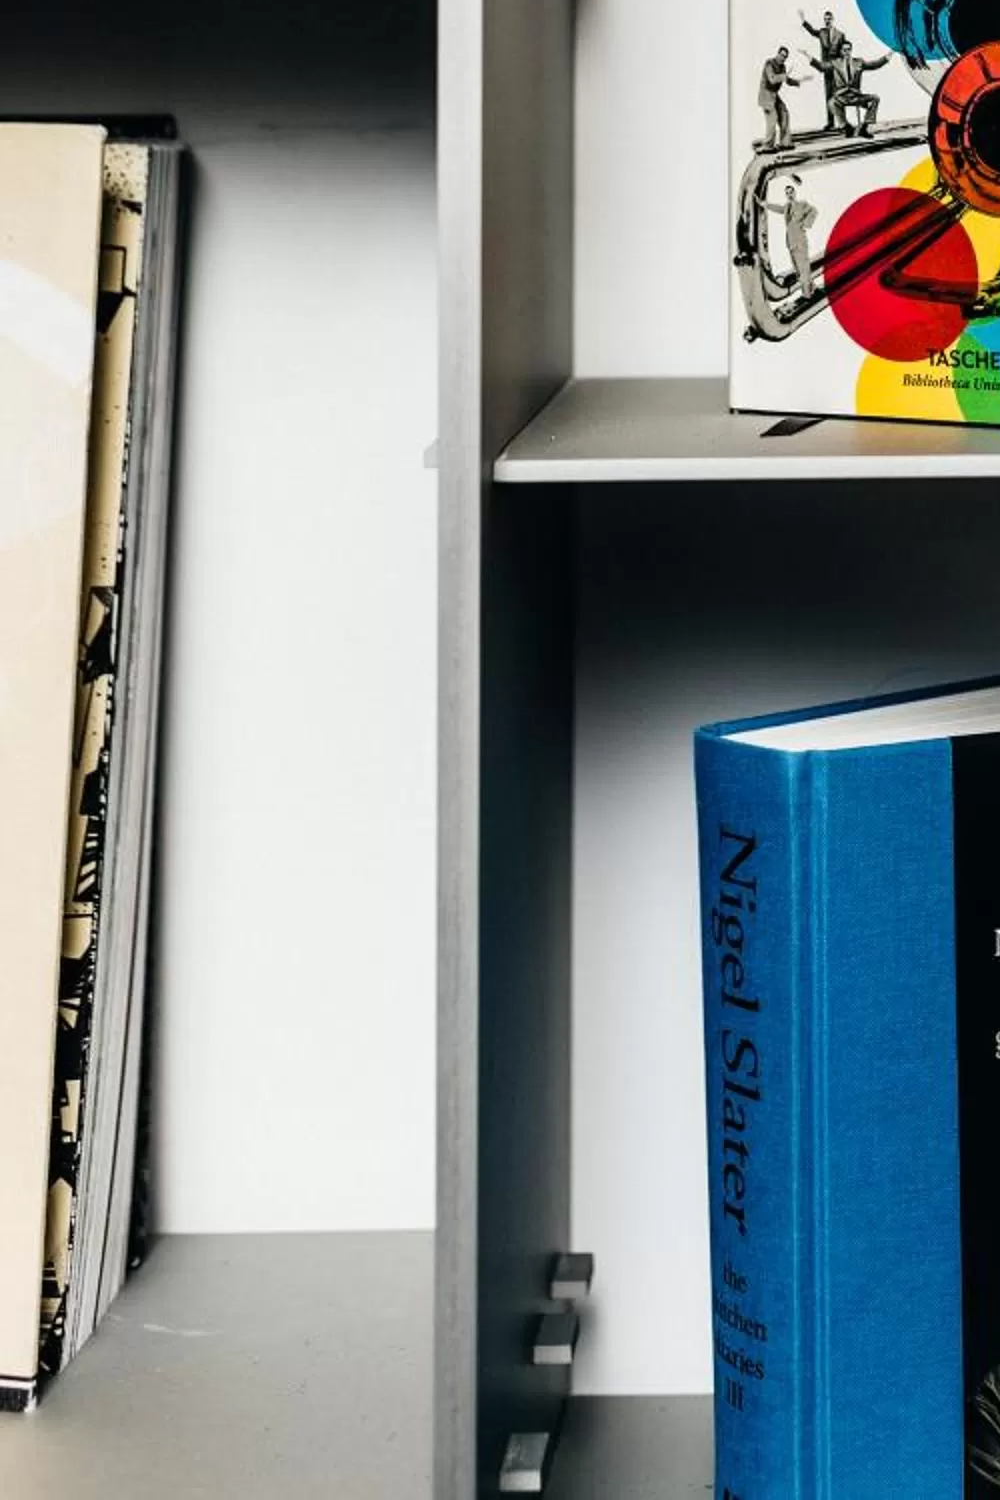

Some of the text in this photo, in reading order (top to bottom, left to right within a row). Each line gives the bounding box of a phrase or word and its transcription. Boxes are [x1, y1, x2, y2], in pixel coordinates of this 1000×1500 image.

[903, 374, 970, 390] Bibliotheca
[711, 825, 761, 1237] Nigel Slater
